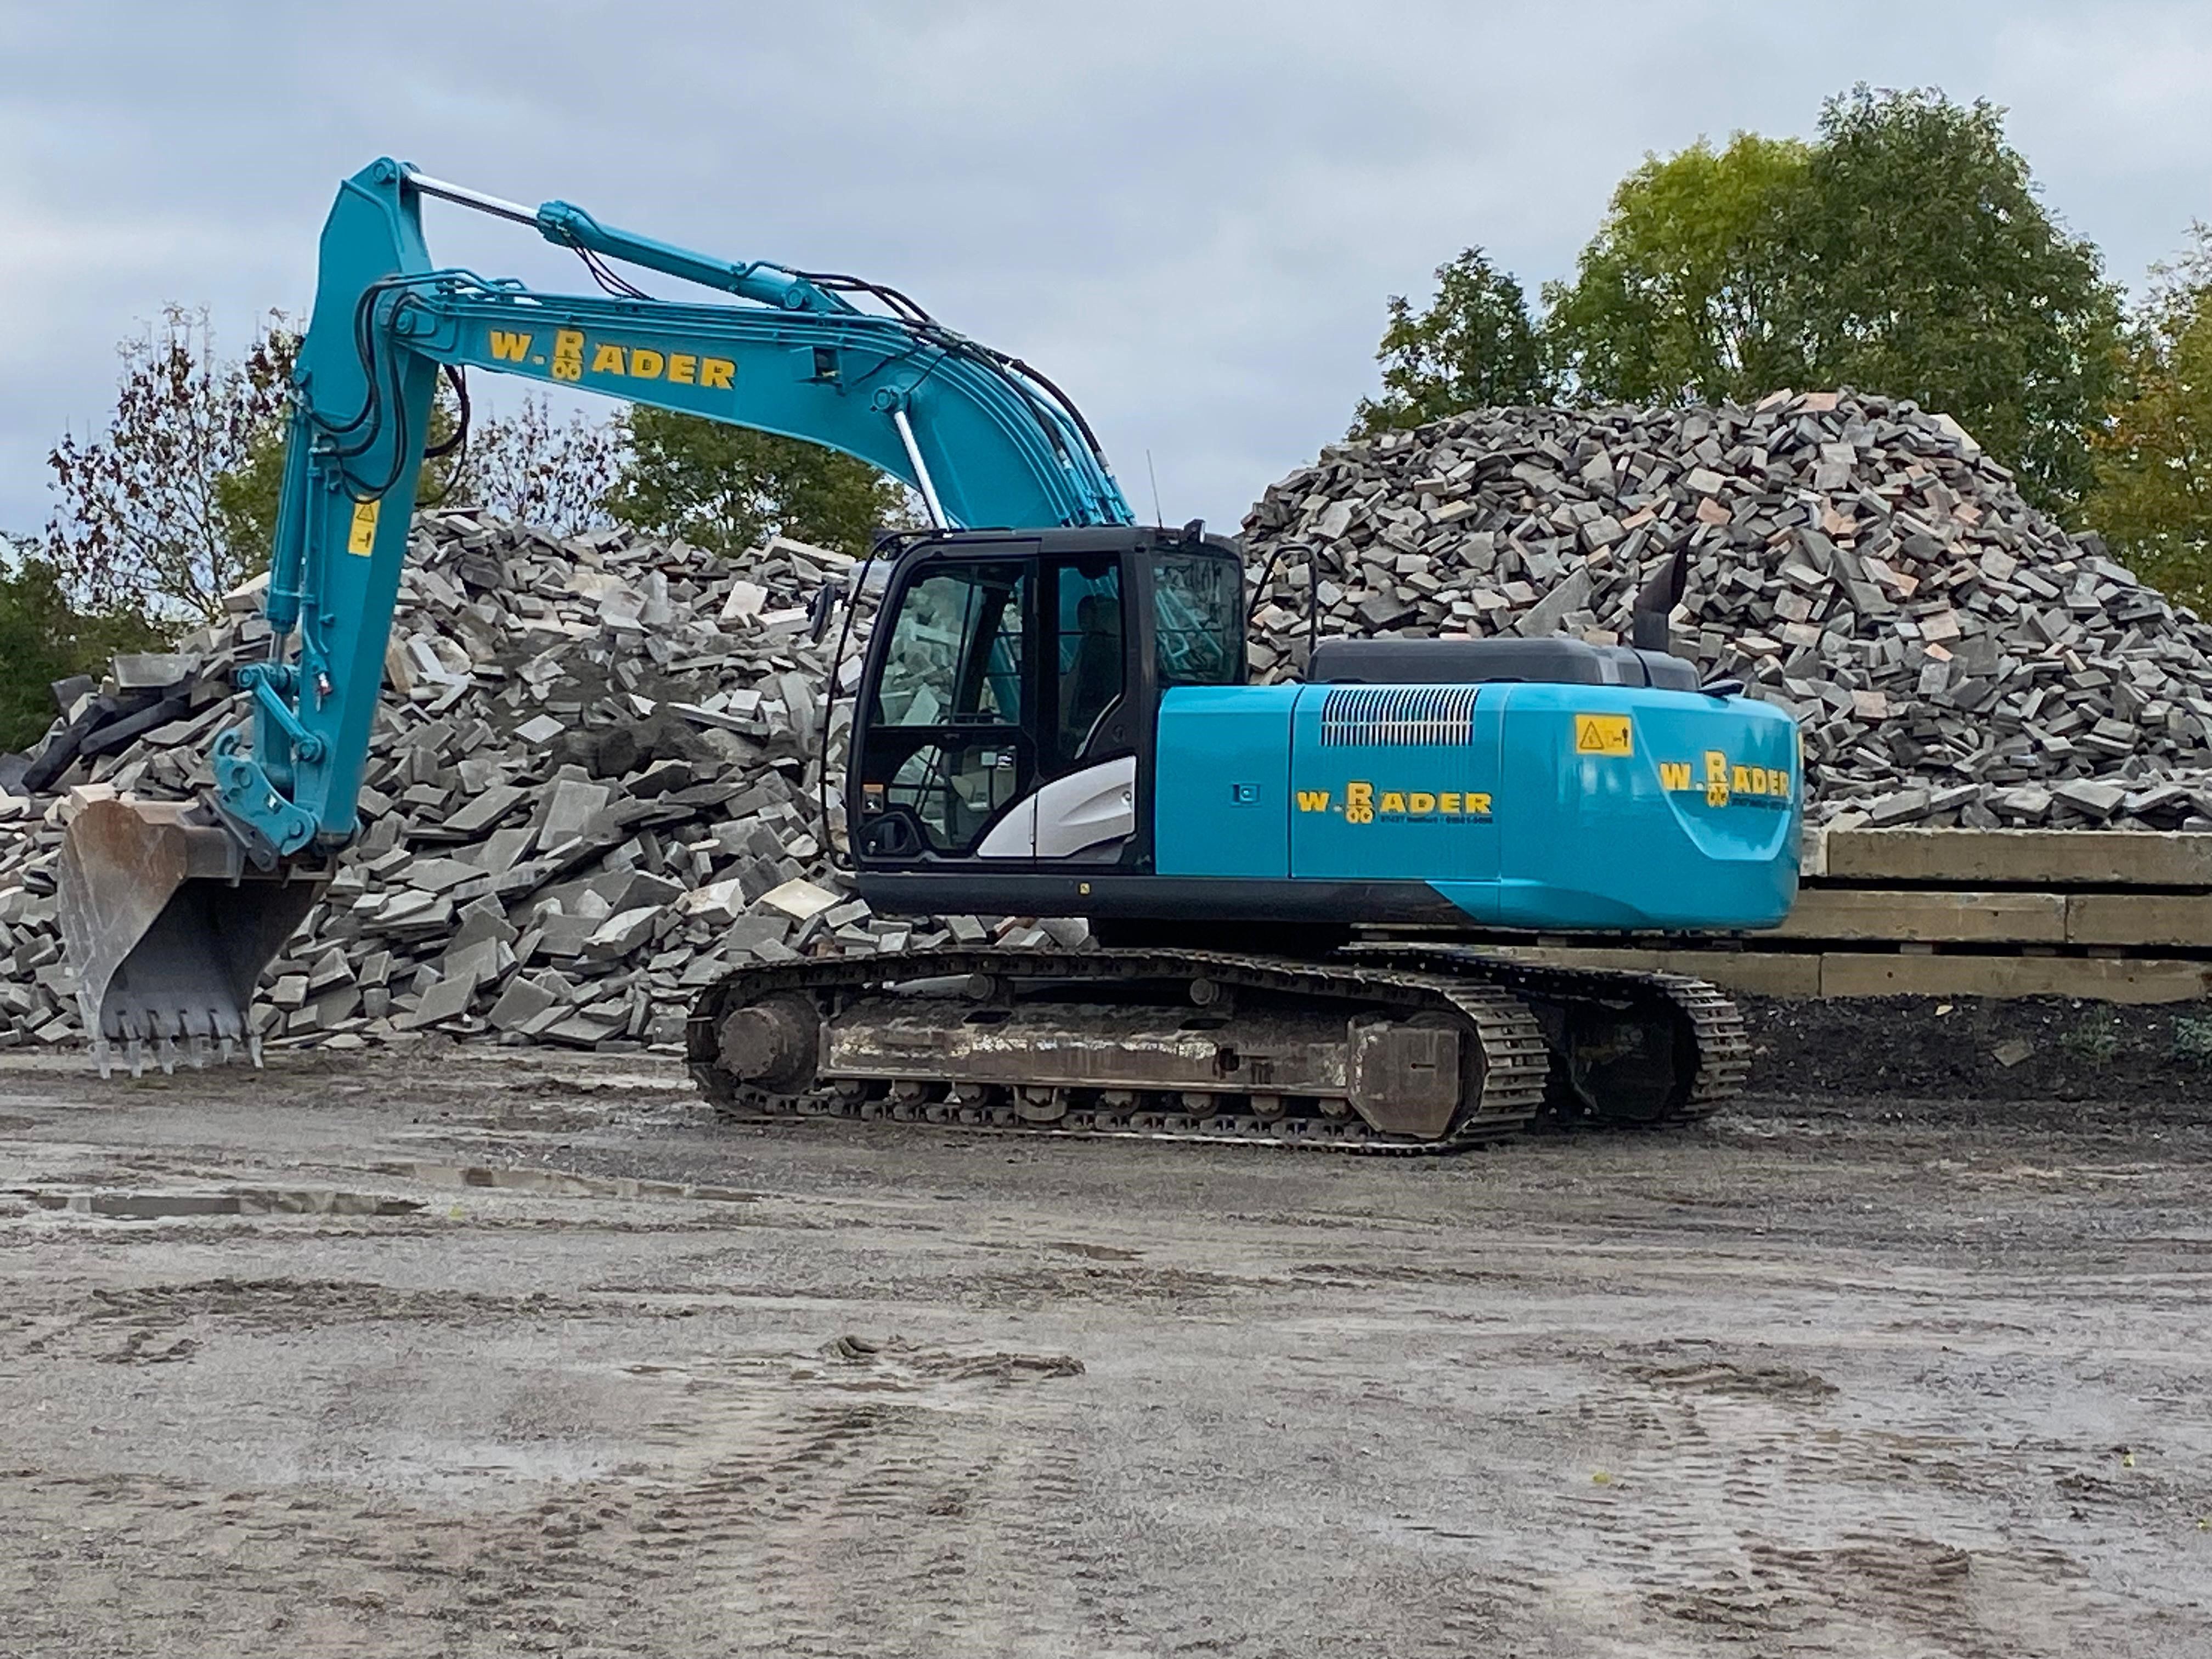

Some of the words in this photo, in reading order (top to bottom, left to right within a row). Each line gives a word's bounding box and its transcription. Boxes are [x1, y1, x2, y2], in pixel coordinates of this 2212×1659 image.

[490, 330, 545, 365] W.
[1659, 763, 1703, 791] W.
[1297, 791, 1342, 812] W.
